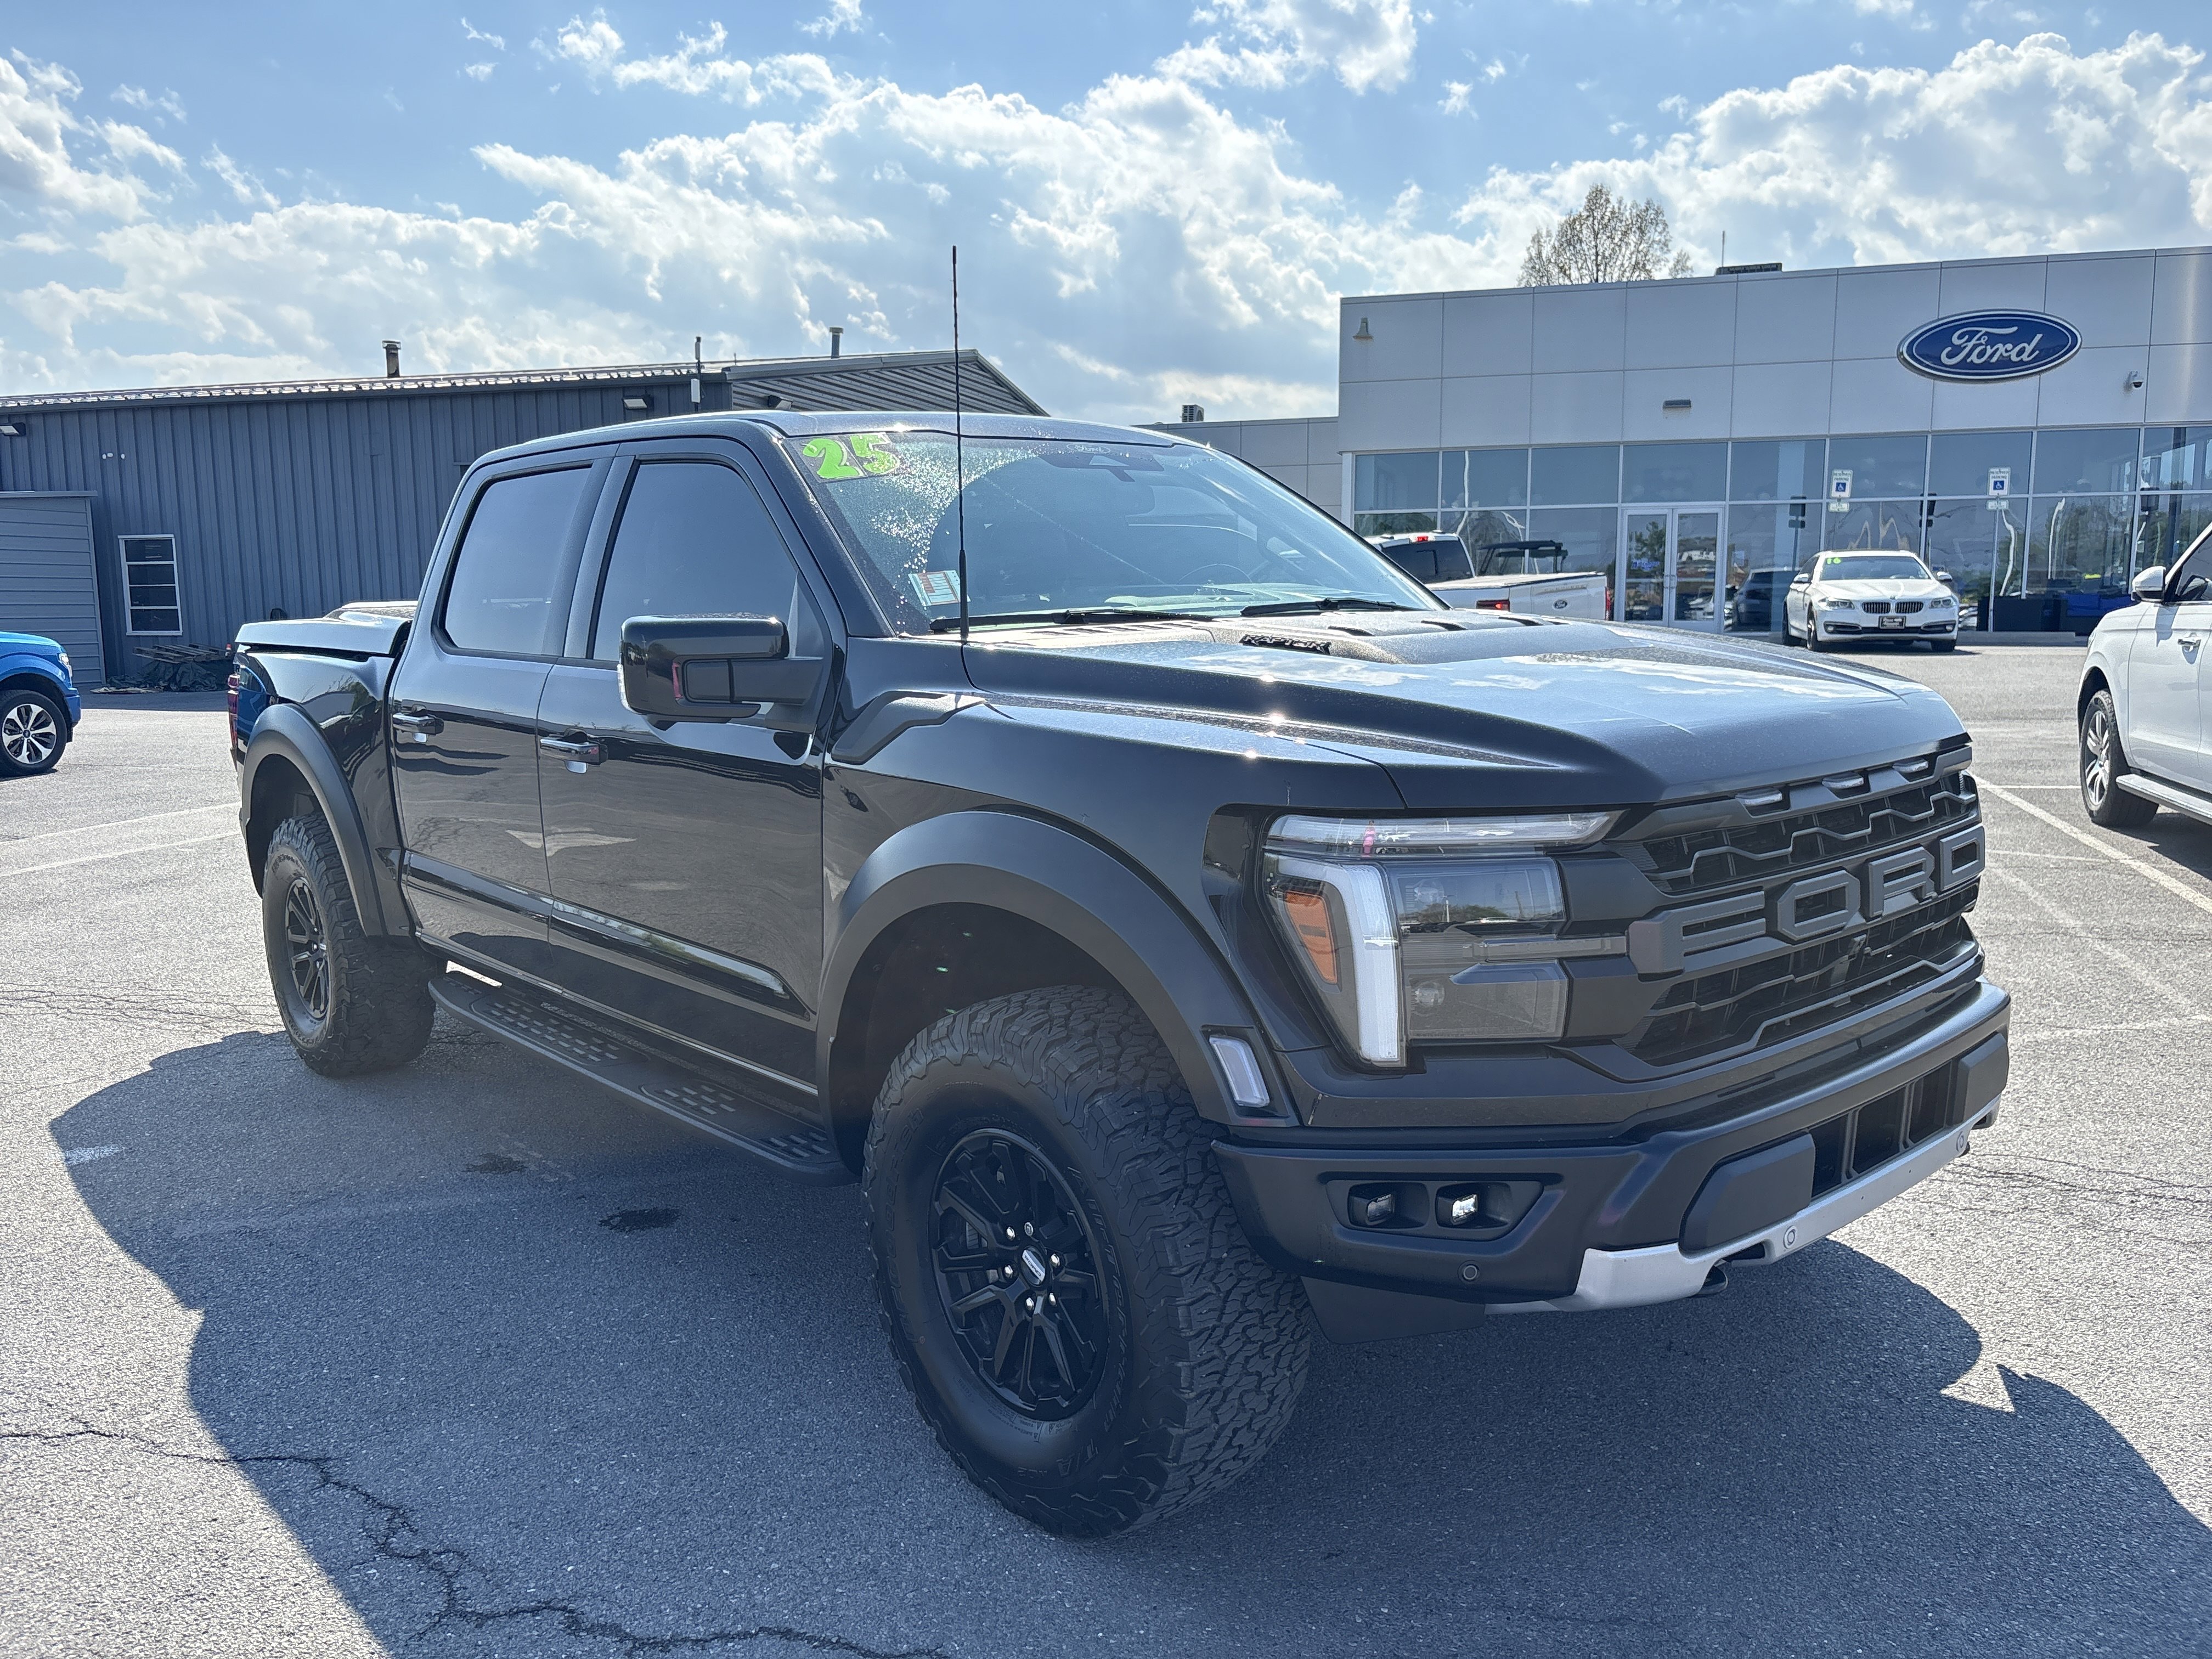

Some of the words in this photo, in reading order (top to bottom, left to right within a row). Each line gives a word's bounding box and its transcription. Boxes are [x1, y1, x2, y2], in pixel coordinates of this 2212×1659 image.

[1940, 326, 2043, 365] Ford
[802, 432, 901, 479] 25
[1242, 634, 1331, 654] RAPTOR
[1627, 825, 1985, 974] FORD
[1024, 1255, 1042, 1277] FORD
